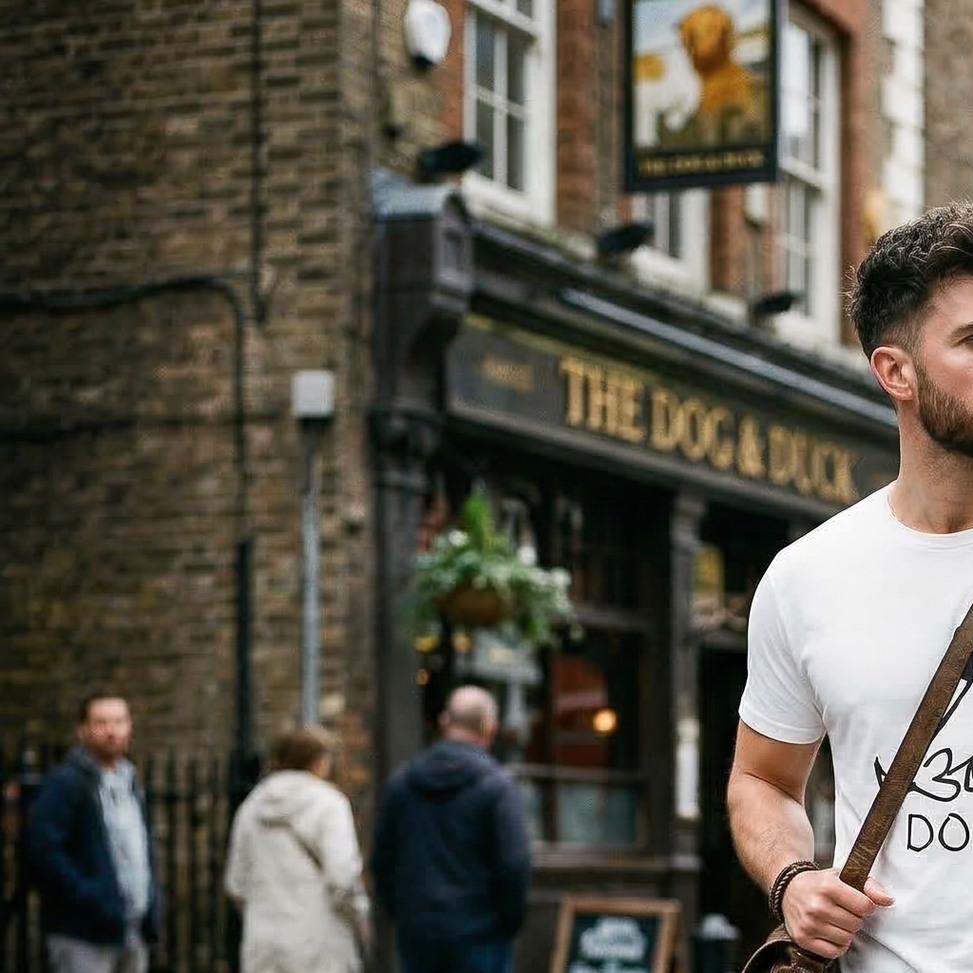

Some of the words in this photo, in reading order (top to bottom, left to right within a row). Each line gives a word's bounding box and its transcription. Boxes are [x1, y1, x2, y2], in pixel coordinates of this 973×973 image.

[559, 357, 645, 444] THE
[651, 387, 733, 471] DOG
[736, 410, 764, 478] &
[767, 424, 858, 504] DUCK
